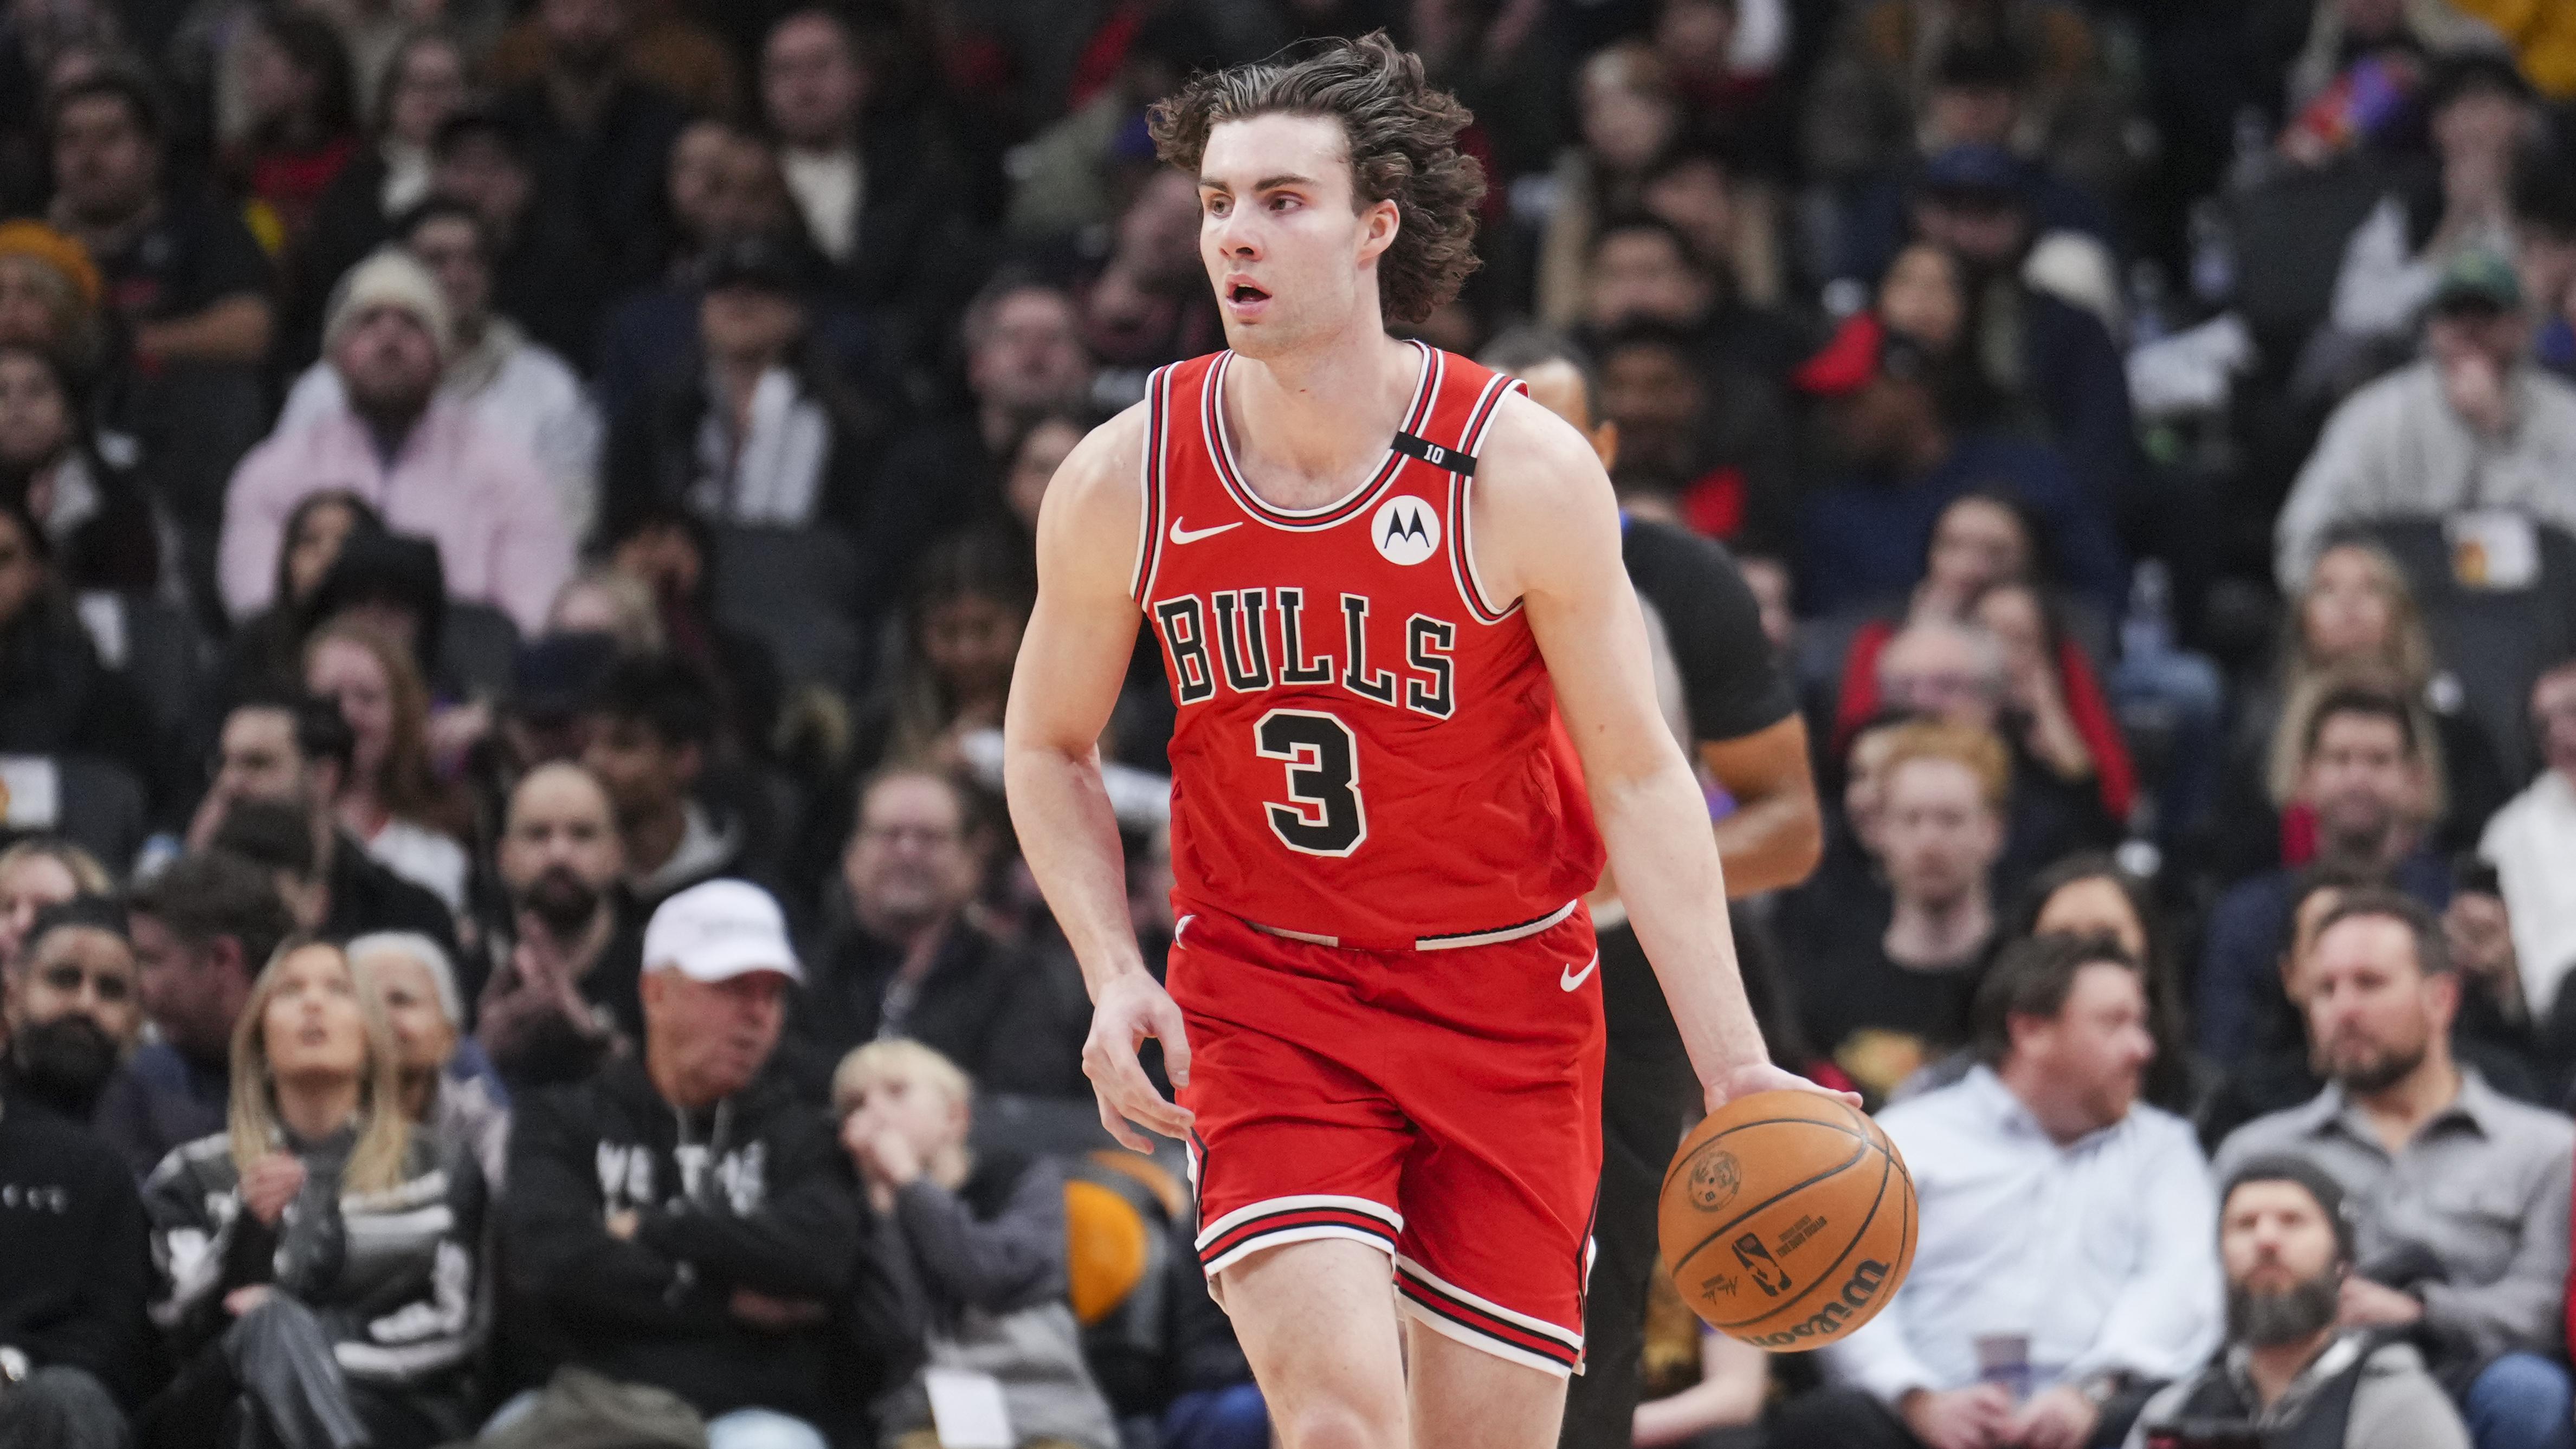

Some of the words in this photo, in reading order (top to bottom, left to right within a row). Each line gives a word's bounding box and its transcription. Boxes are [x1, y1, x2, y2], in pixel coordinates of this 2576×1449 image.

[1423, 444, 1444, 464] 10
[1153, 587, 1456, 720] BULLS
[1254, 708, 1367, 857] 3
